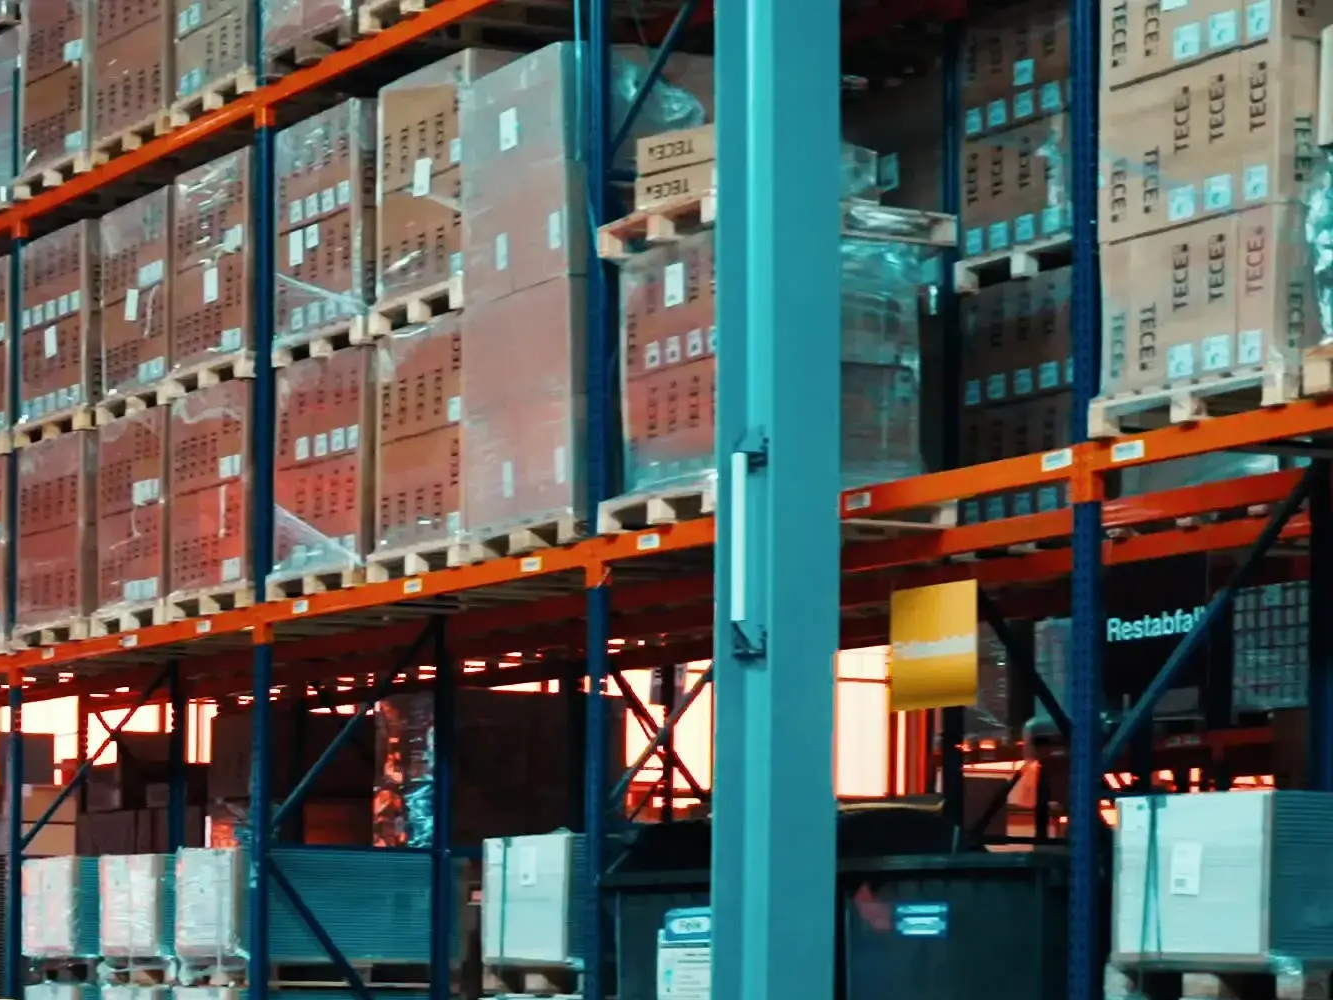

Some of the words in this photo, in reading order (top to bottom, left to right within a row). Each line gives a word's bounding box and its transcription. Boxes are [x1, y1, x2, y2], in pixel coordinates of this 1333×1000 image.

[1144, 2, 1160, 47] ECE
[1174, 95, 1190, 155] TECE
[1209, 83, 1225, 144] TECE
[1249, 72, 1266, 133] TECE
[656, 139, 694, 161] TECE
[1294, 113, 1312, 169] TECE
[653, 179, 689, 200] TECE
[1111, 157, 1126, 211] TECE
[1143, 145, 1160, 201] TECE
[1173, 254, 1189, 313] TECE
[1208, 245, 1225, 304] TECE
[1246, 235, 1264, 296] TECE
[1139, 301, 1156, 360] TECE
[1288, 281, 1304, 336] TECE
[1107, 606, 1206, 641] Restabfal
